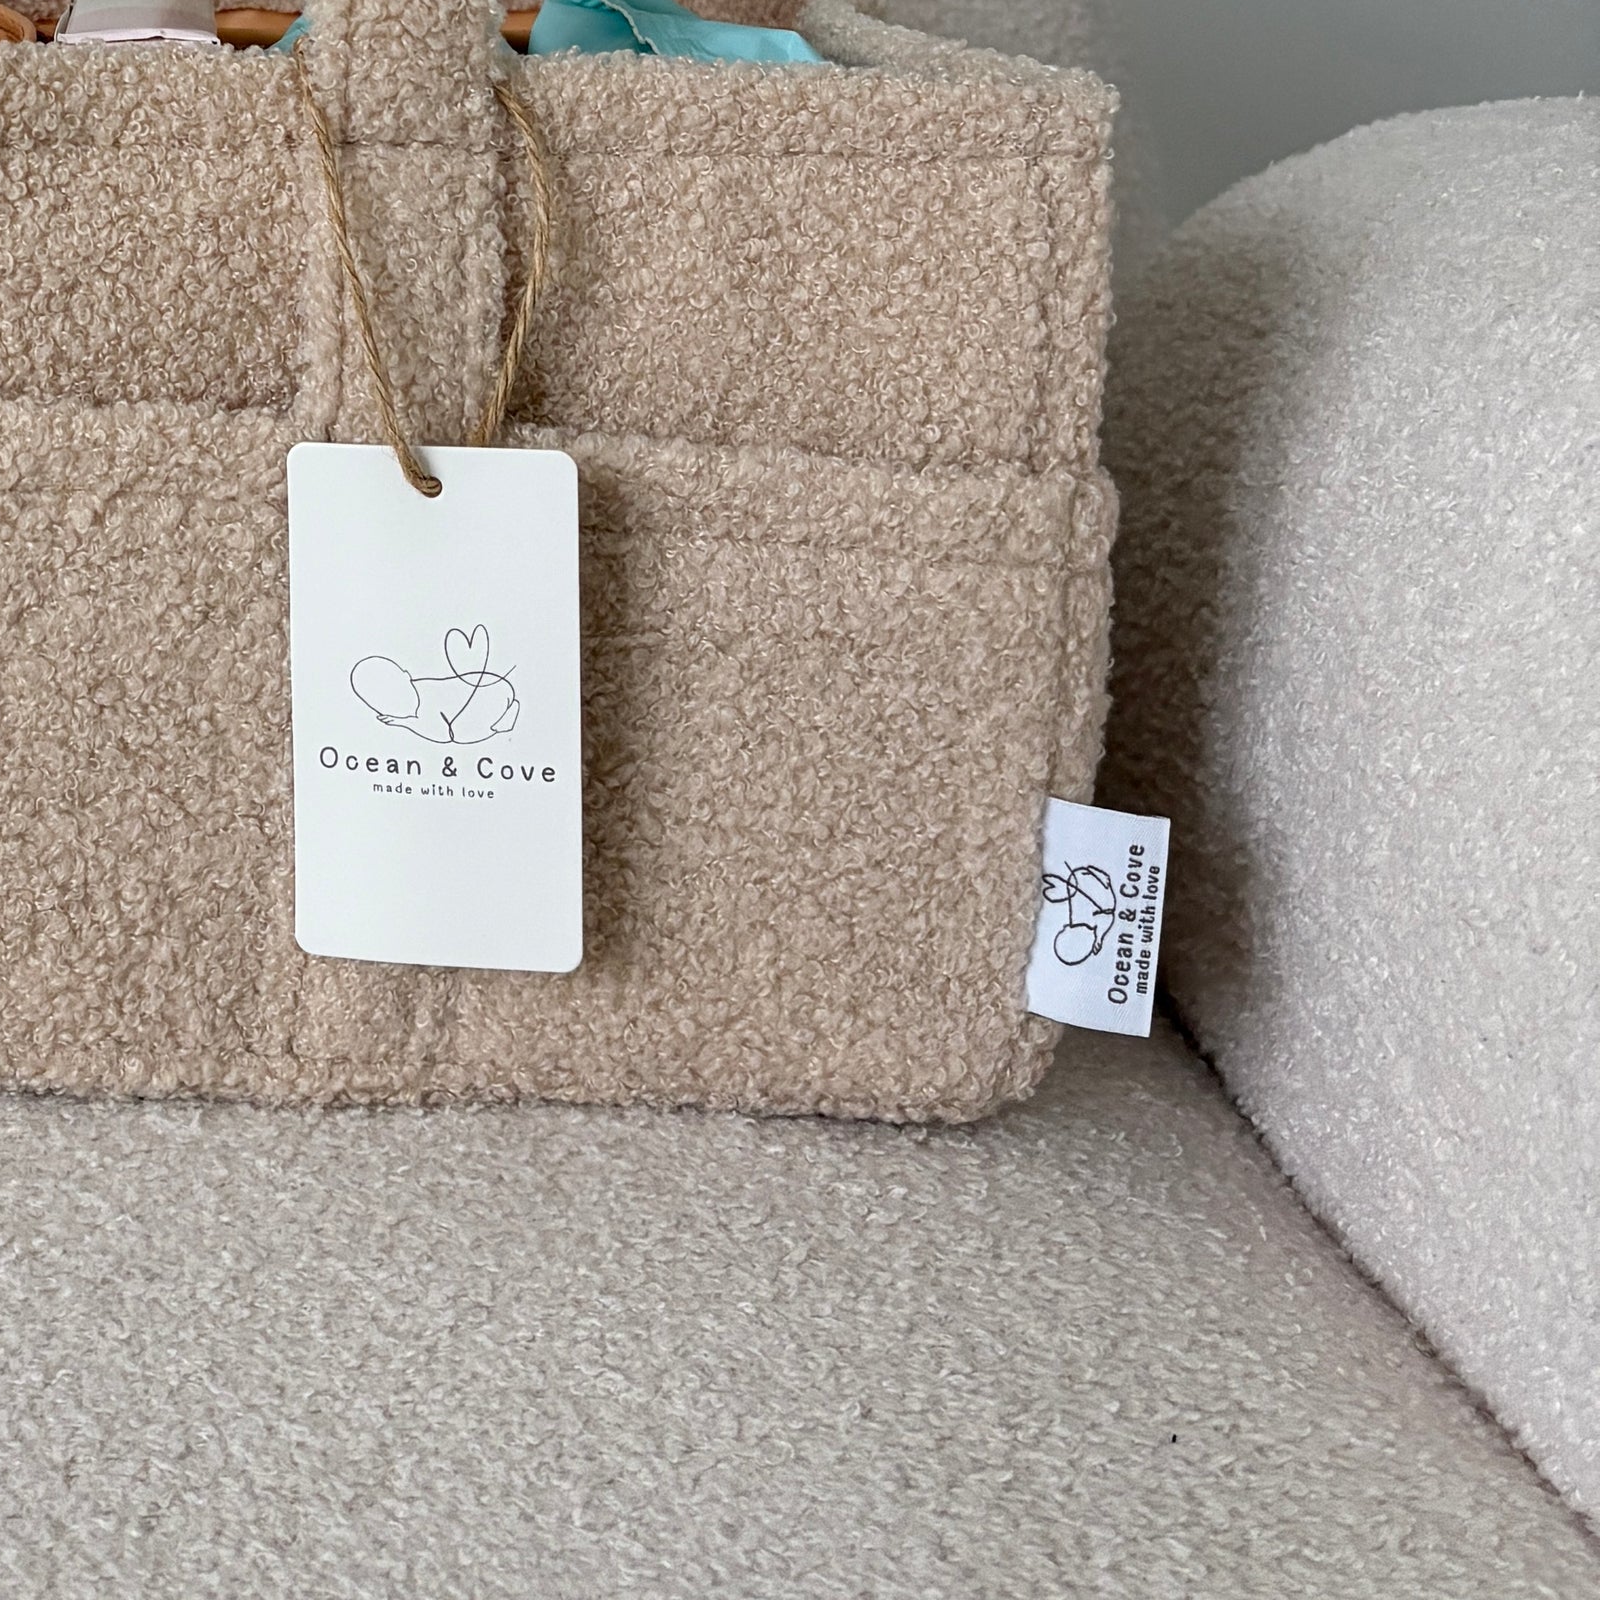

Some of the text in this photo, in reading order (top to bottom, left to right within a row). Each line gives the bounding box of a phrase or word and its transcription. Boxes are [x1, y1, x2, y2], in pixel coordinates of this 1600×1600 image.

[319, 746, 556, 782] Ocean & Cove
[373, 782, 495, 800] made with love
[1107, 844, 1145, 1005] Ocean & Cove
[1134, 865, 1160, 995] made with love
